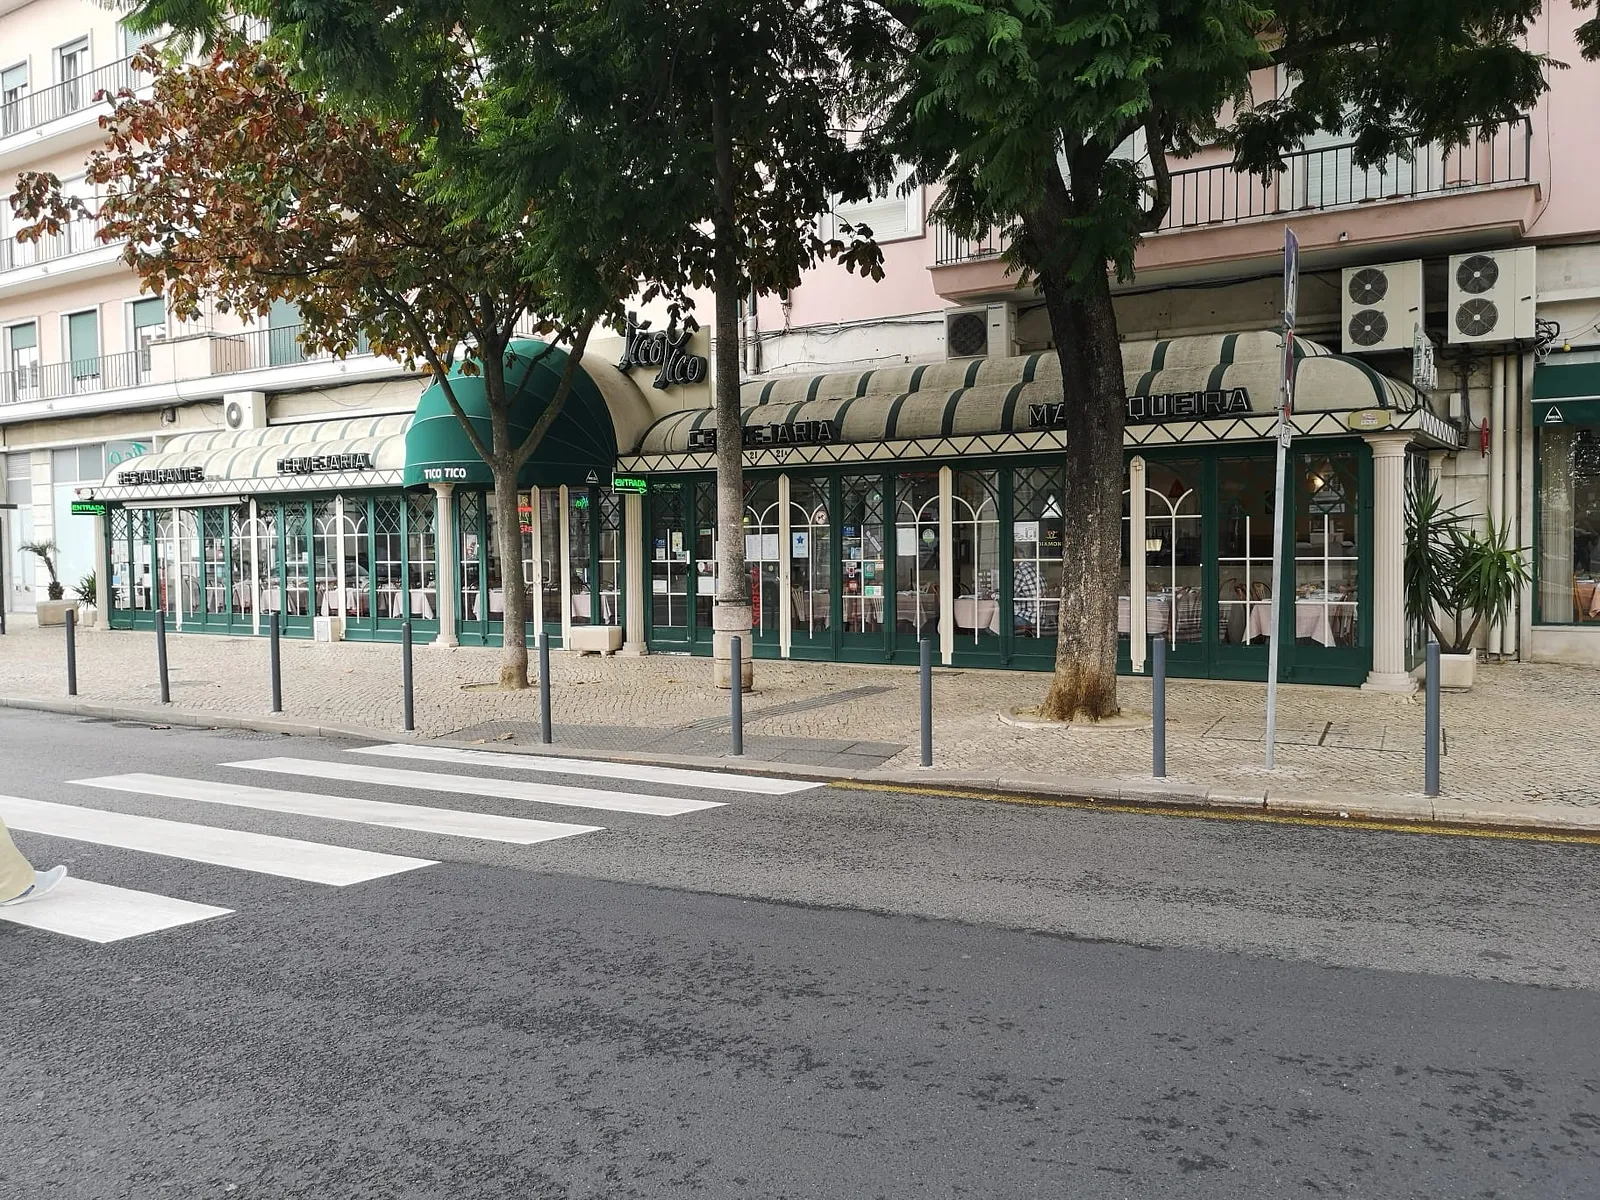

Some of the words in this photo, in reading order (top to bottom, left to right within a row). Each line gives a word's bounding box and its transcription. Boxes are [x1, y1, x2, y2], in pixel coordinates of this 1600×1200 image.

[1029, 389, 1249, 425] MAQUEIRA
[688, 421, 833, 447] CEEJARIA
[749, 451, 758, 459] 21
[424, 468, 442, 480] TICO
[444, 468, 467, 478] TICO
[614, 478, 647, 488] ENTRADA
